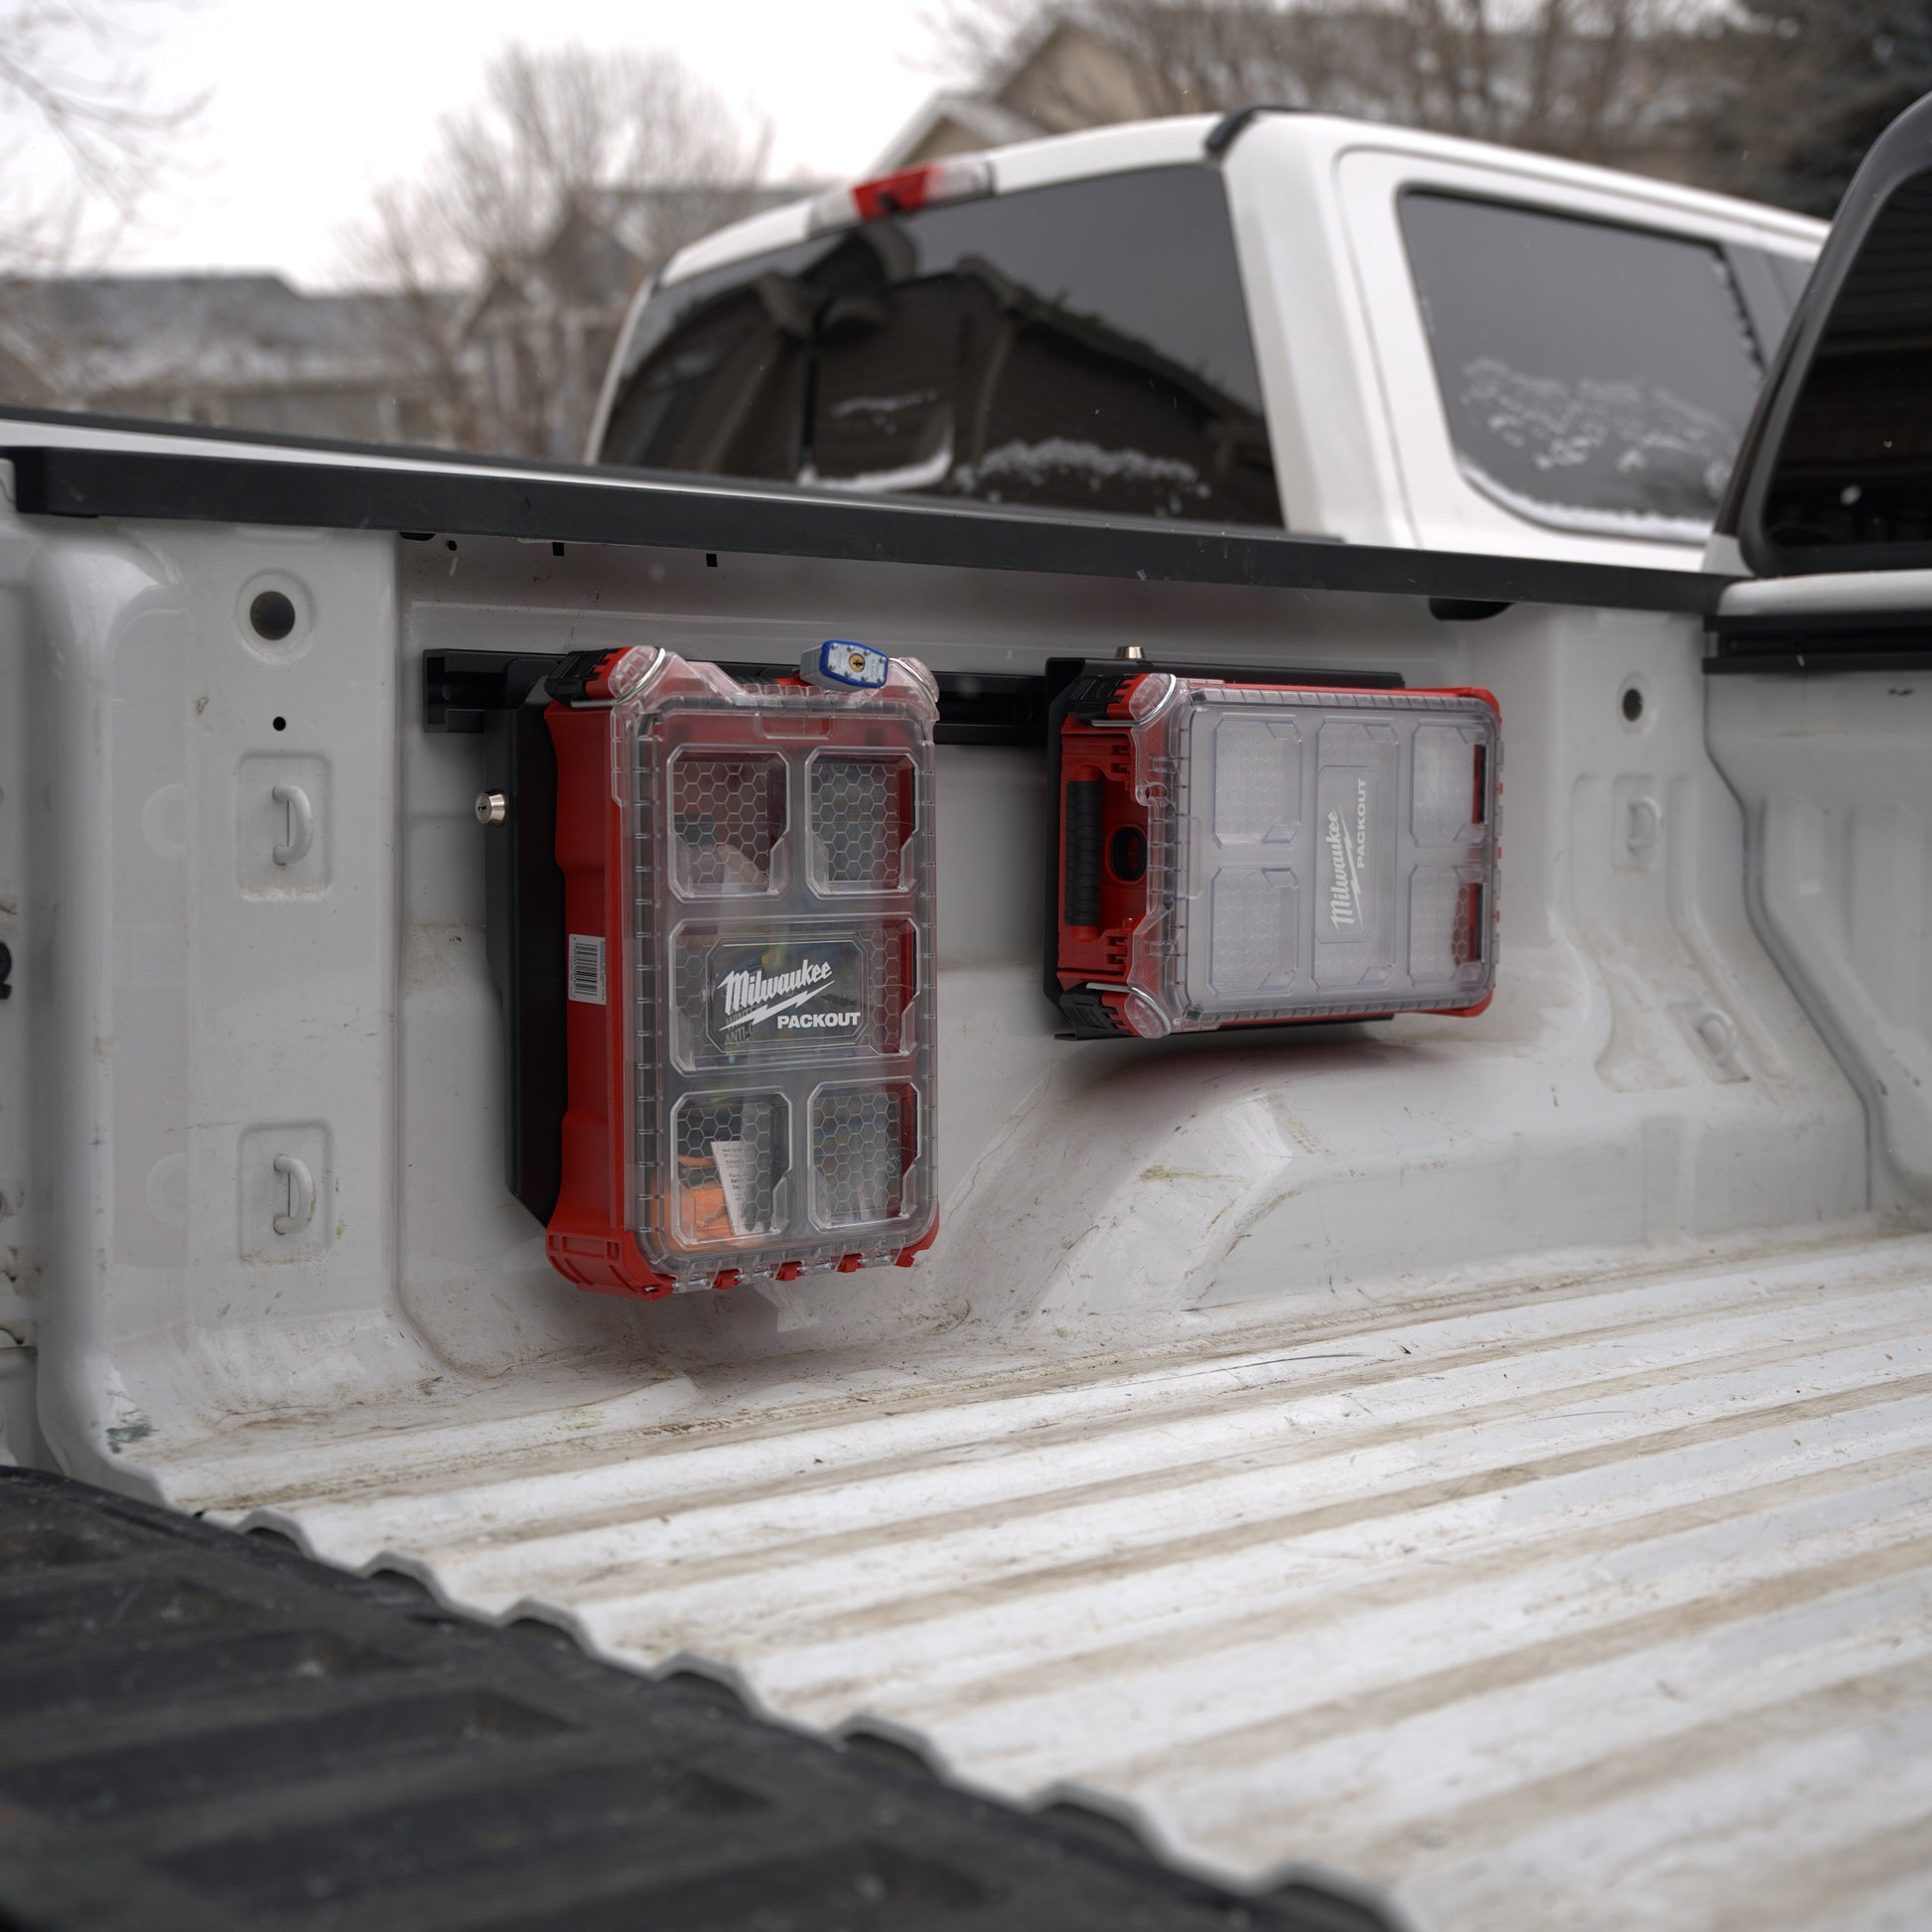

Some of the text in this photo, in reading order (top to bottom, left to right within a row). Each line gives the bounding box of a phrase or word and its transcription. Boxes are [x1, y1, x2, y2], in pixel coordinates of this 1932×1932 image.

[1357, 778, 1366, 869] PACKOUT
[1325, 809, 1355, 931] Milwaukee
[717, 959, 833, 1016] Milwaukee
[777, 1012, 861, 1029] PACKOUT
